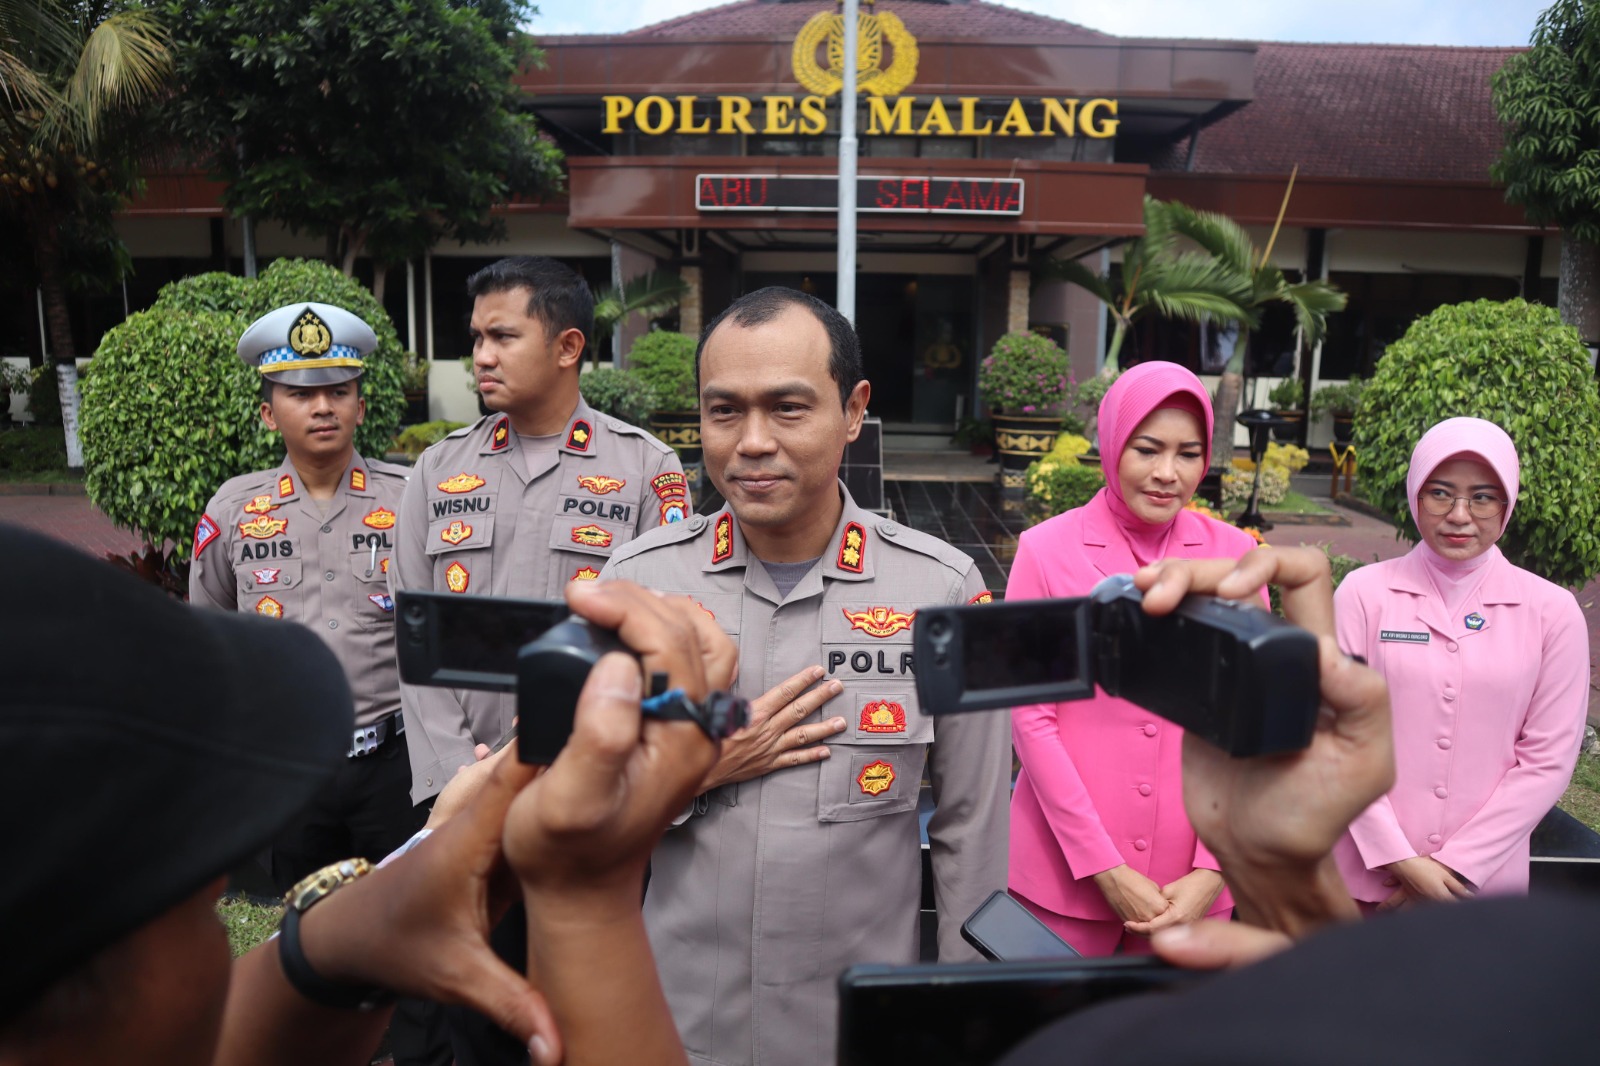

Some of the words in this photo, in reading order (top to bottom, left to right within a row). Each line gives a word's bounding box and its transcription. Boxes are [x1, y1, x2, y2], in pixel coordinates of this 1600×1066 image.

[602, 95, 827, 135] POLRES
[866, 96, 1120, 138] MALANG
[700, 177, 768, 207] ABU
[875, 179, 1020, 211] SELAMA
[433, 497, 491, 518] WISNU
[563, 498, 631, 522] POLRI
[241, 540, 294, 562] ADIS
[828, 650, 916, 675] POLR
